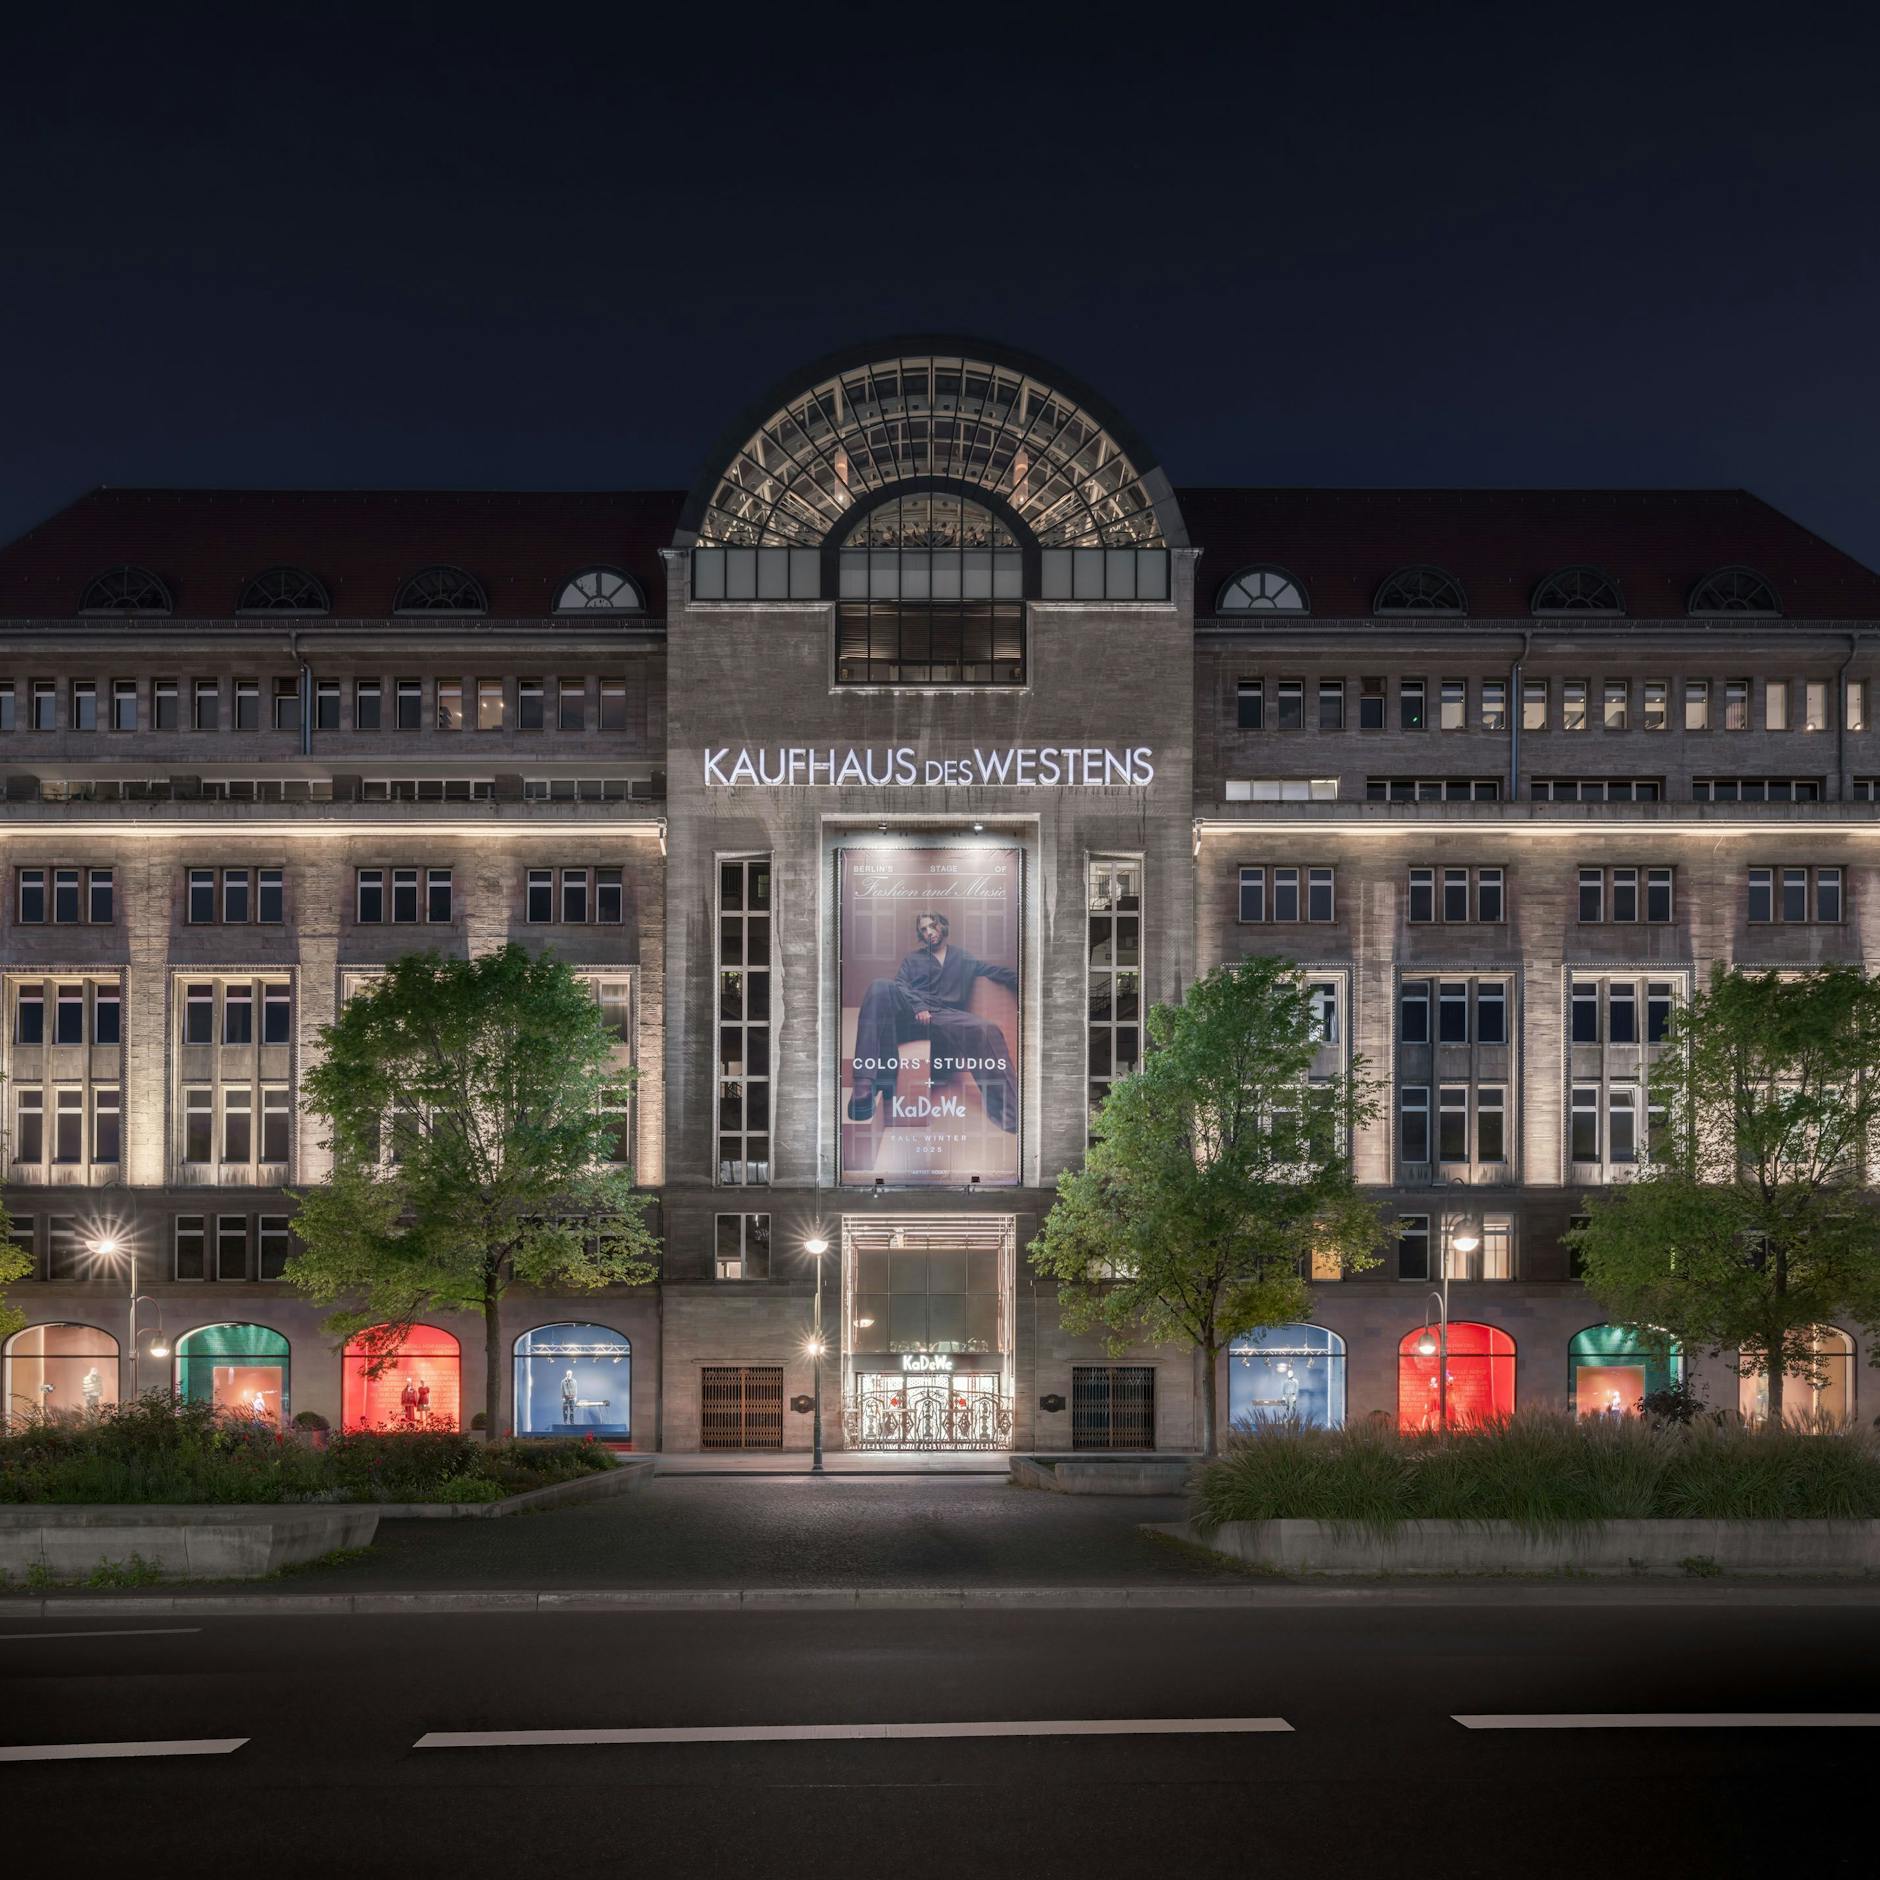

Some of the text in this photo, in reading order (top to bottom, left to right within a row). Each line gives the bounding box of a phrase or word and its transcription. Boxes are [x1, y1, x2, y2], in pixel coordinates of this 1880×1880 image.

[704, 747, 1155, 786] KAUFHAUS DES WESTENS
[853, 865, 1007, 873] BERLIN'S STAGE OF
[855, 876, 1006, 897] Fashion and Music
[852, 1058, 1007, 1070] COLORS STUDIOS
[892, 1096, 966, 1118] KaDeWe
[902, 1355, 953, 1371] KaDeWe
